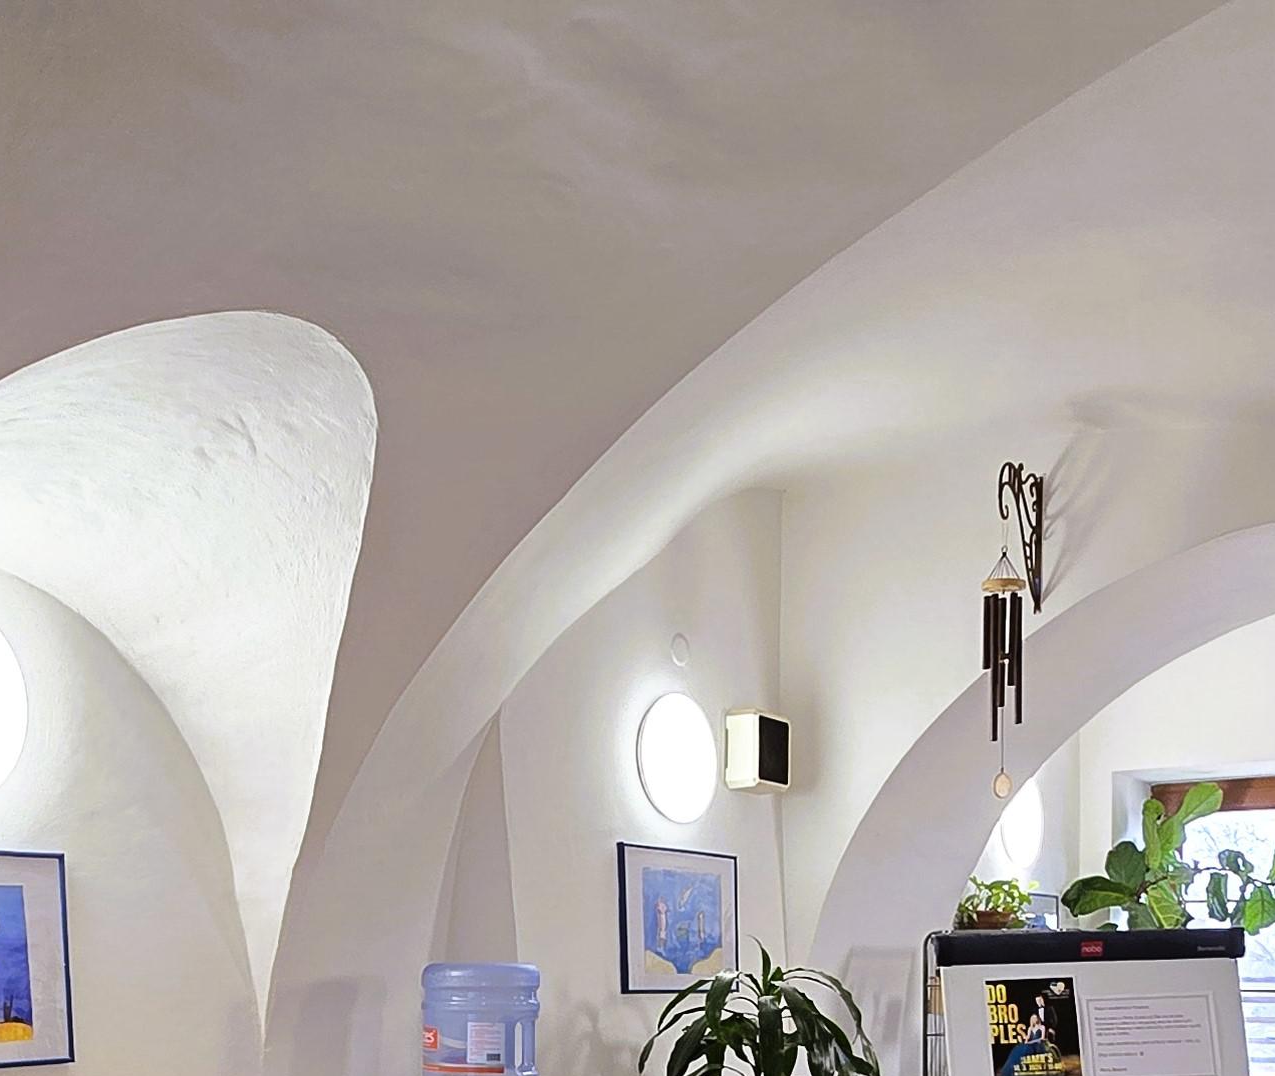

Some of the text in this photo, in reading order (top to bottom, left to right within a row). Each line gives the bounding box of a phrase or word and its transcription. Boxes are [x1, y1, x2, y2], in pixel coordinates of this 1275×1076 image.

[1081, 944, 1103, 954] nobo
[985, 984, 1008, 1004] DO
[988, 1004, 1020, 1024] BRO
[990, 1024, 1030, 1045] PLES
